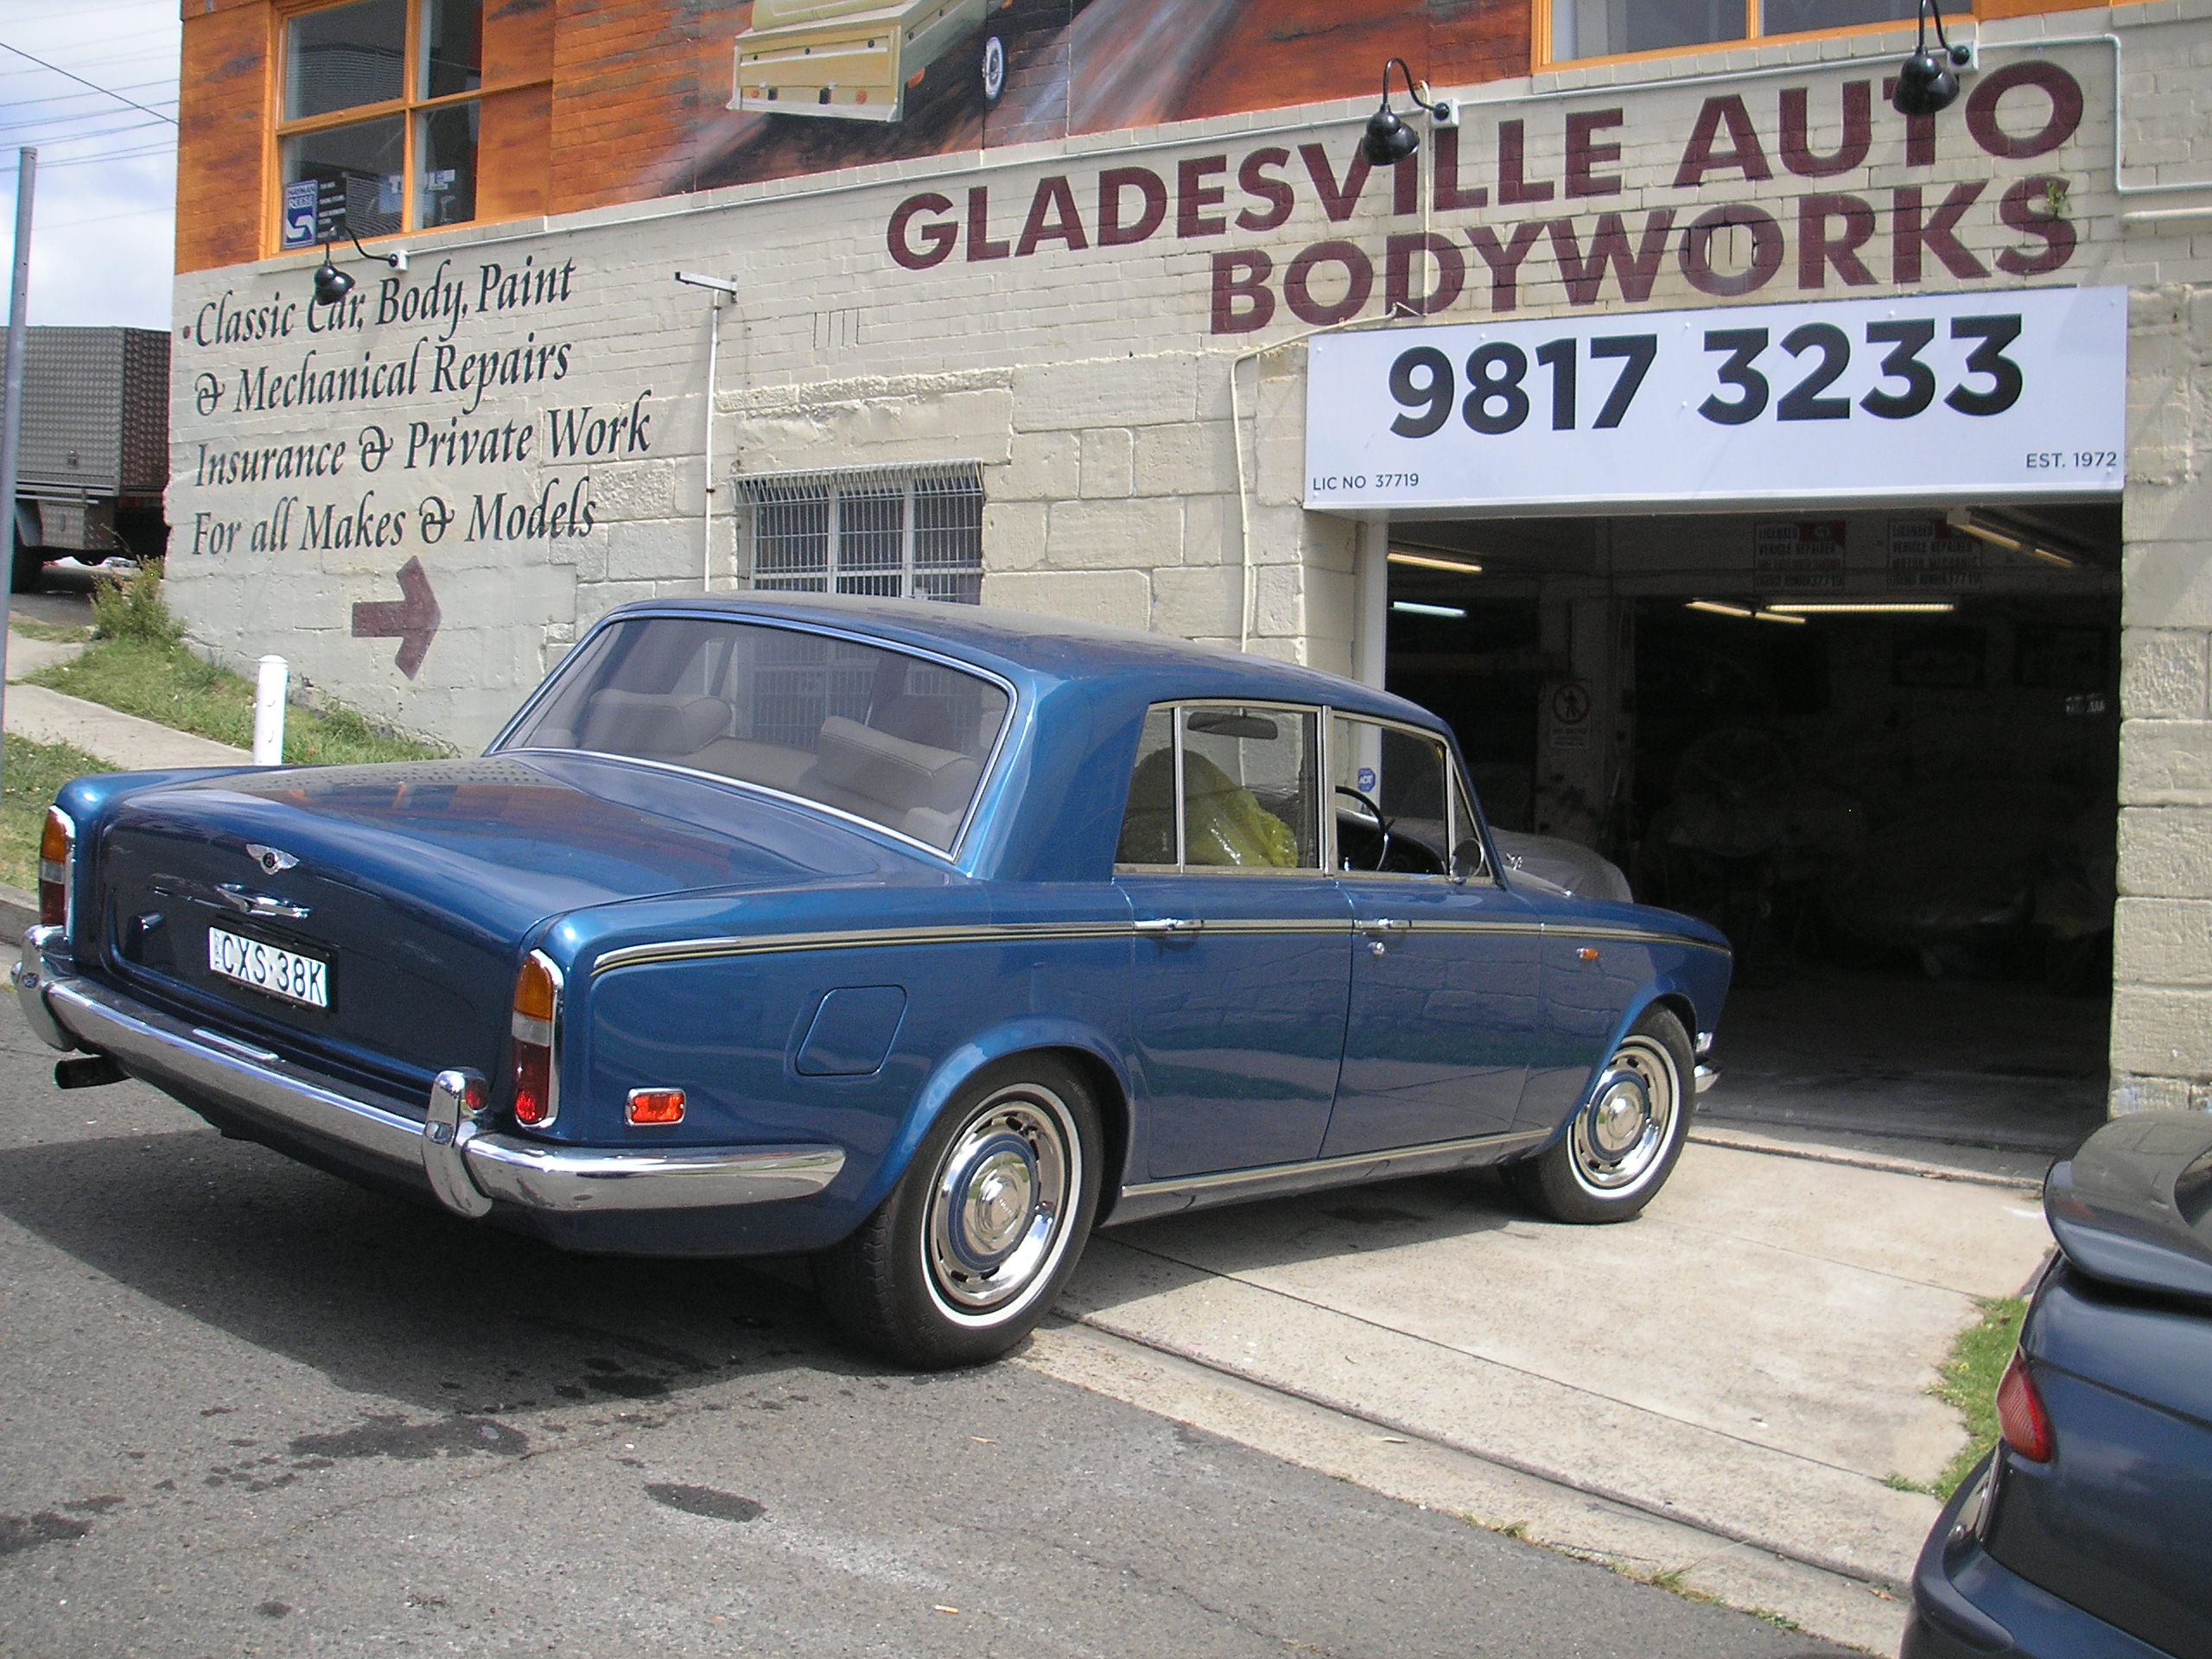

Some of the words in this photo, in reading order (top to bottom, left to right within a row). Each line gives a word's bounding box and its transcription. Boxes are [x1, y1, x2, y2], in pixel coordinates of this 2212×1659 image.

[886, 106, 1624, 270] GLADESVILLE
[1672, 60, 2084, 189] AUTO
[1210, 175, 2078, 334] BODYWORKS
[195, 289, 296, 346] Classic
[375, 259, 468, 342] Body,
[477, 255, 576, 312] Paint
[194, 372, 226, 416] &
[232, 338, 429, 413] Mechanical
[430, 332, 571, 415] Repairs
[1389, 334, 1657, 438] 9817
[1697, 314, 2024, 426] 3233
[194, 440, 347, 486] Insurance
[359, 425, 394, 473] &
[404, 417, 533, 472] Private
[548, 389, 652, 457] Work
[1313, 476, 1338, 491] LIC
[1342, 475, 1367, 489] NO
[1375, 473, 1419, 488] 37719
[2025, 453, 2066, 469] EST.
[2073, 451, 2118, 467] 1972
[192, 511, 242, 555] For
[250, 496, 299, 553] all
[299, 490, 407, 551] Makes
[419, 496, 454, 544] &
[464, 476, 597, 543] Models
